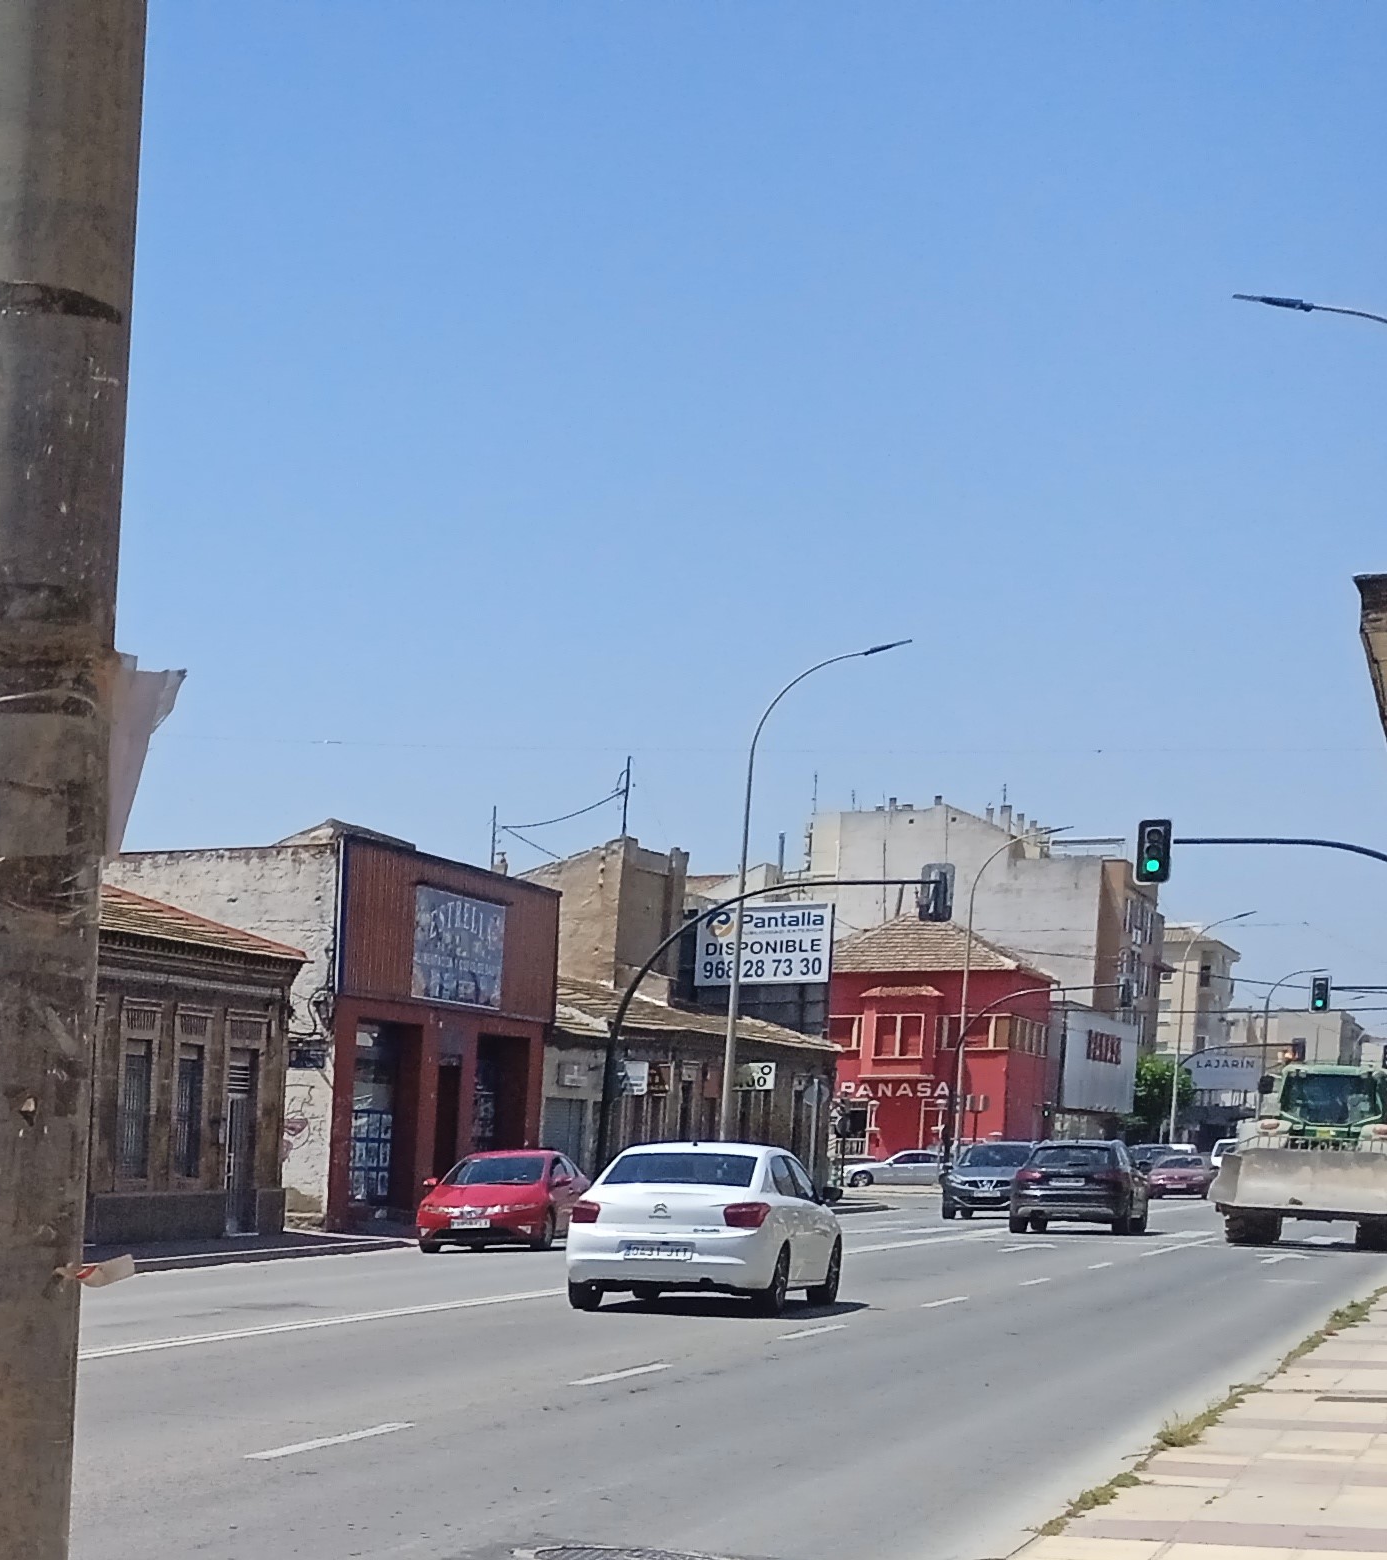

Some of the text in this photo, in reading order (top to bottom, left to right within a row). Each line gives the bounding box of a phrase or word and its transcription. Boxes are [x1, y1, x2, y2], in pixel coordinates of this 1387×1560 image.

[742, 911, 825, 929] Pantalla
[705, 938, 823, 957] DISPONIBLE
[742, 959, 766, 978] 28
[772, 958, 793, 977] 73
[799, 957, 822, 976] 30
[840, 1080, 951, 1098] PANASA
